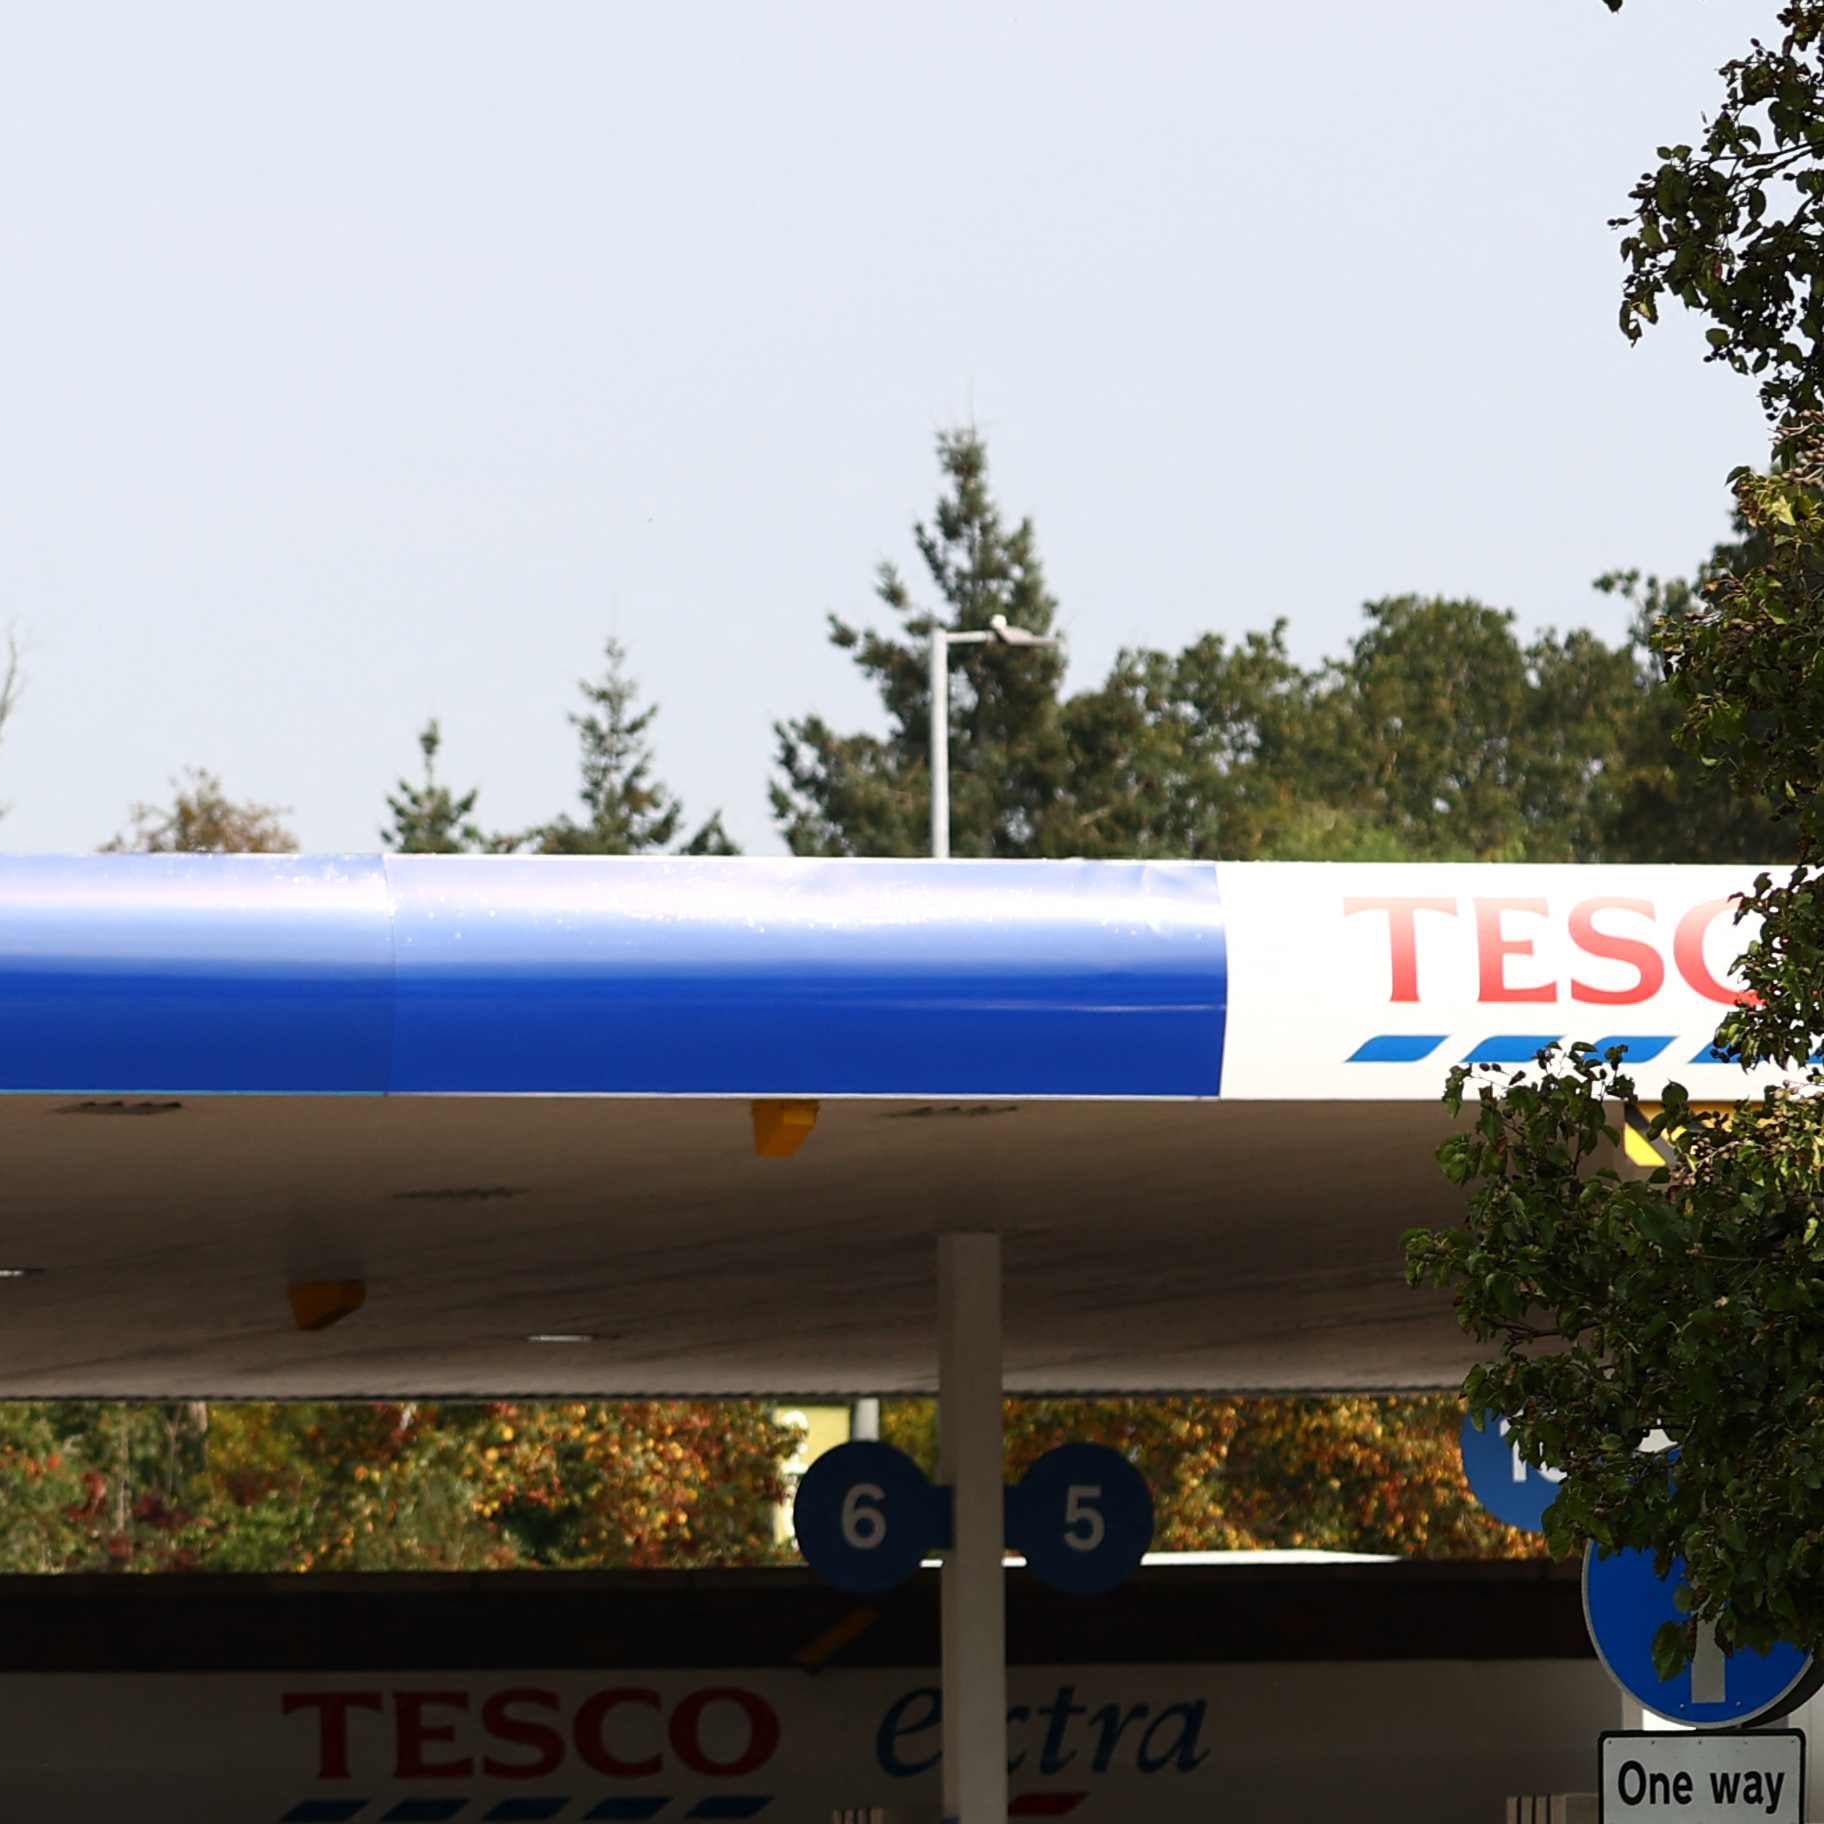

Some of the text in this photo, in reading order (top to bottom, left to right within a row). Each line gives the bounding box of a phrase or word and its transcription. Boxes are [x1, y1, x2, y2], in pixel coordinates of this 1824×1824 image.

[1343, 897, 1767, 1006] TESC
[843, 1484, 886, 1549] 6
[1064, 1485, 1104, 1550] 5
[282, 1685, 1210, 1779] TESCO etra
[1617, 1760, 1785, 1815] One way
